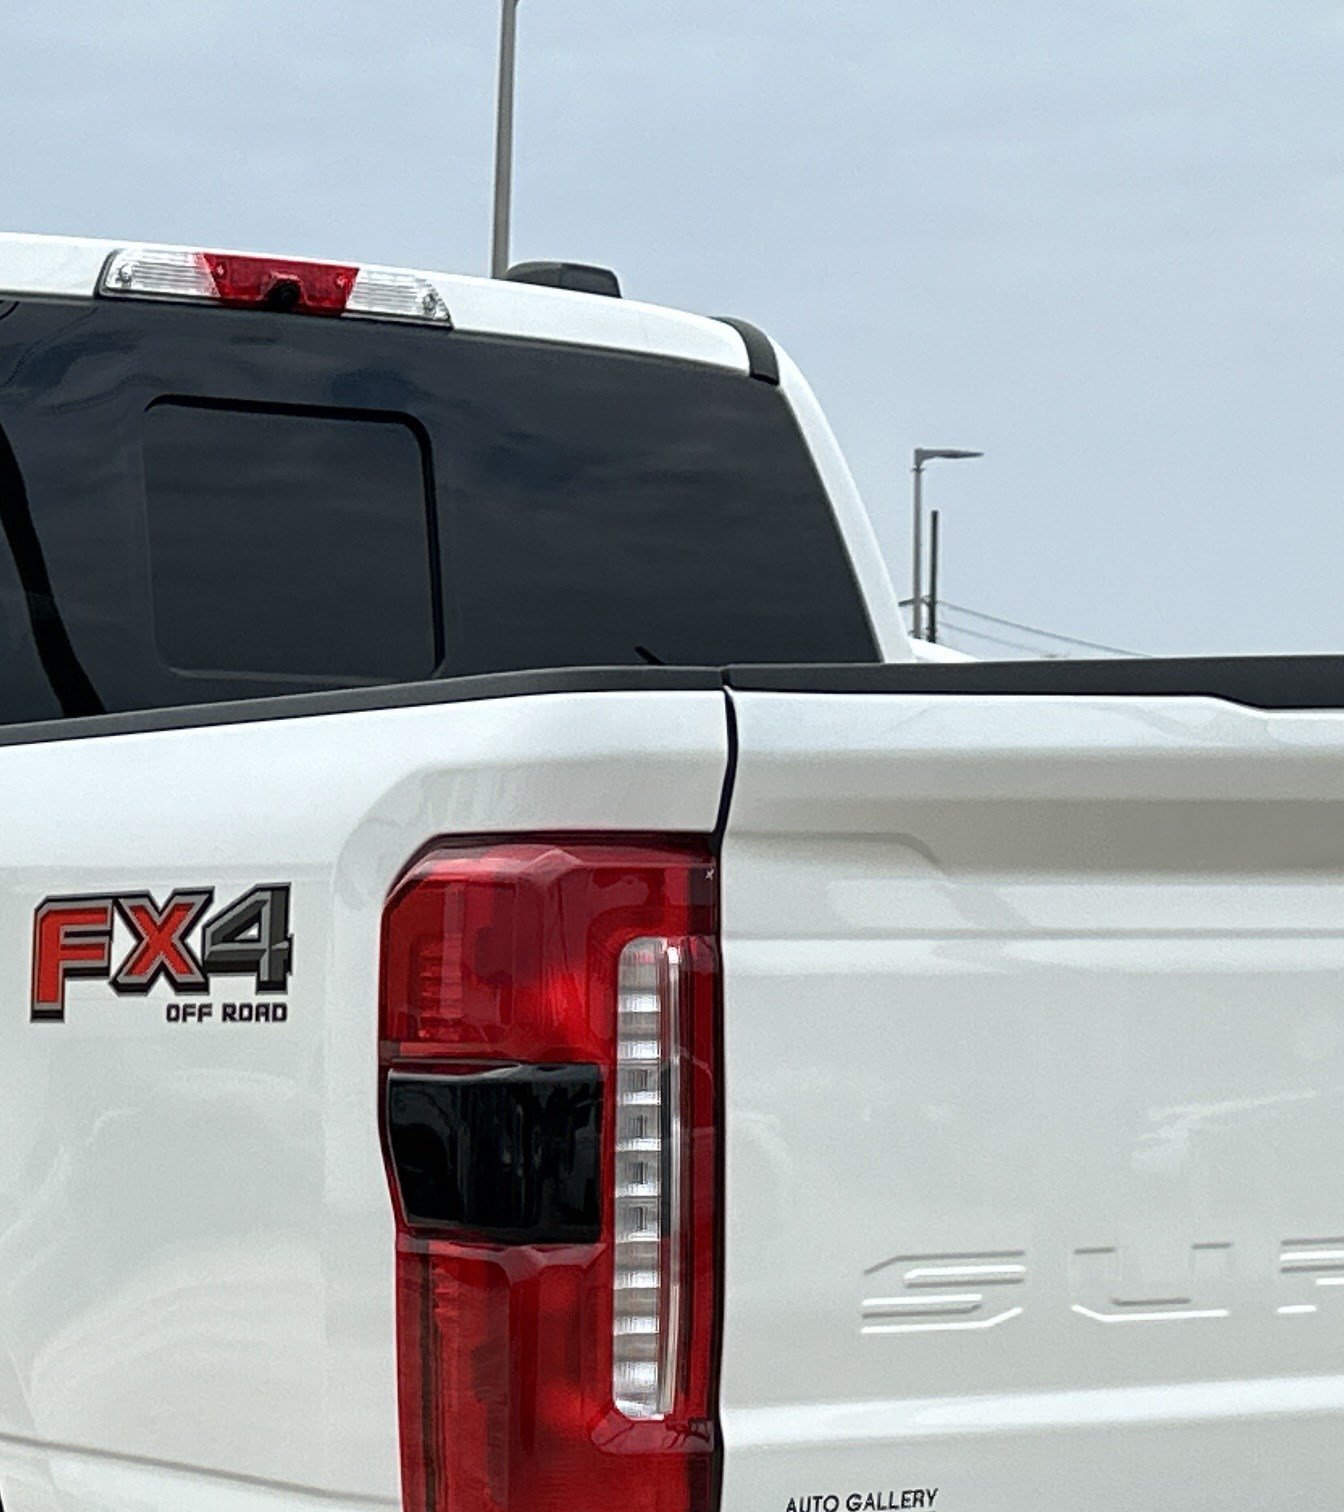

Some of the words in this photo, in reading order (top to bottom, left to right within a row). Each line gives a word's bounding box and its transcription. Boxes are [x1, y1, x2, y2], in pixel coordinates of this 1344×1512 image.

[30, 882, 294, 1023] FX4
[166, 1002, 213, 1023] OFF
[221, 1002, 288, 1023] ROAD
[845, 1487, 939, 1512] GALLERY
